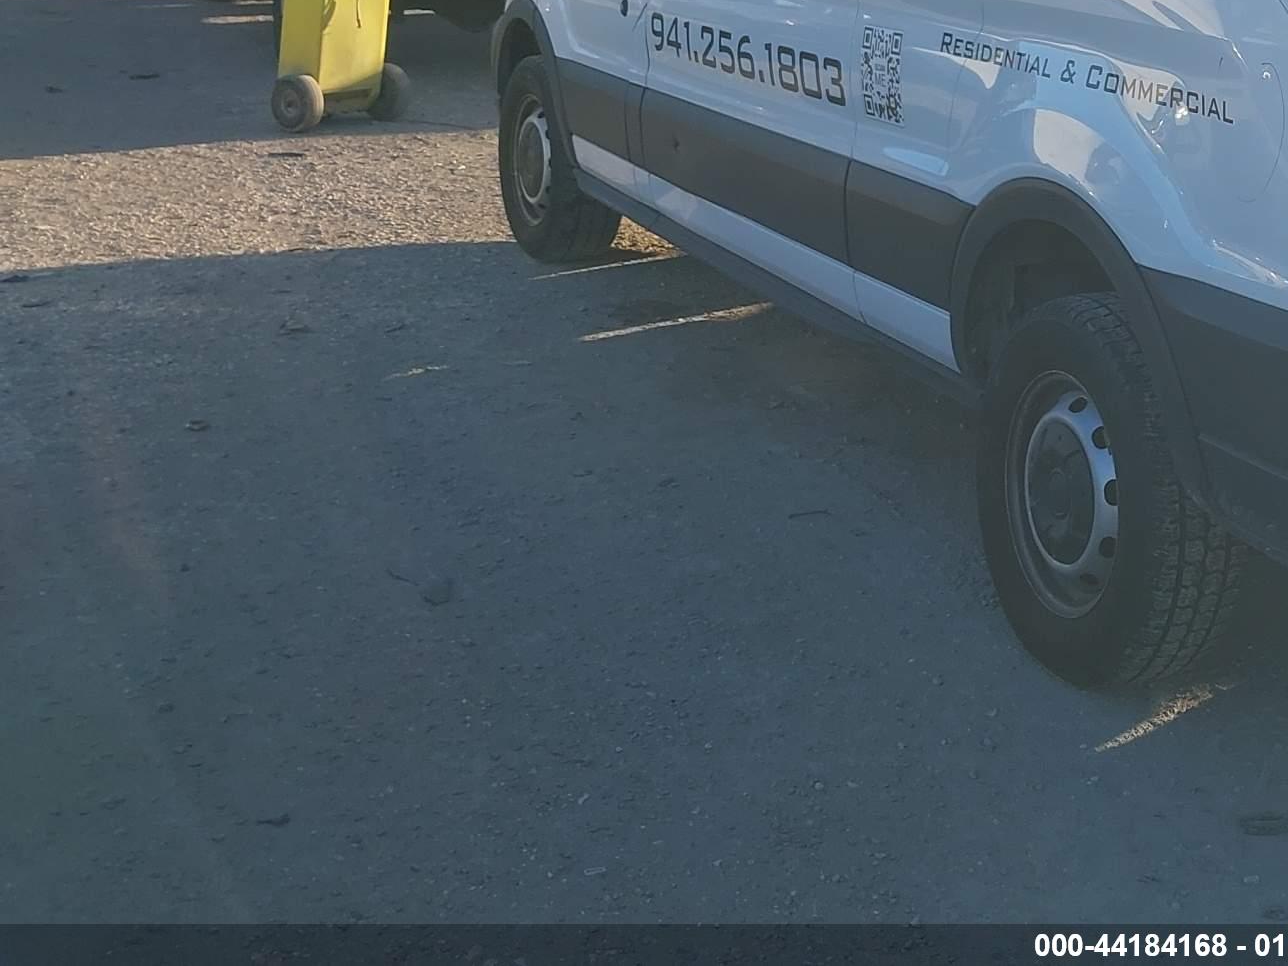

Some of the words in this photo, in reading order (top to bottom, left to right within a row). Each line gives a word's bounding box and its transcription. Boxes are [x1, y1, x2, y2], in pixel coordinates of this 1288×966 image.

[650, 12, 846, 107] 941.256.1803
[940, 32, 1052, 80] RESIDENTIAL
[1059, 59, 1077, 83] &
[1085, 64, 1235, 124] COMMERCIAL
